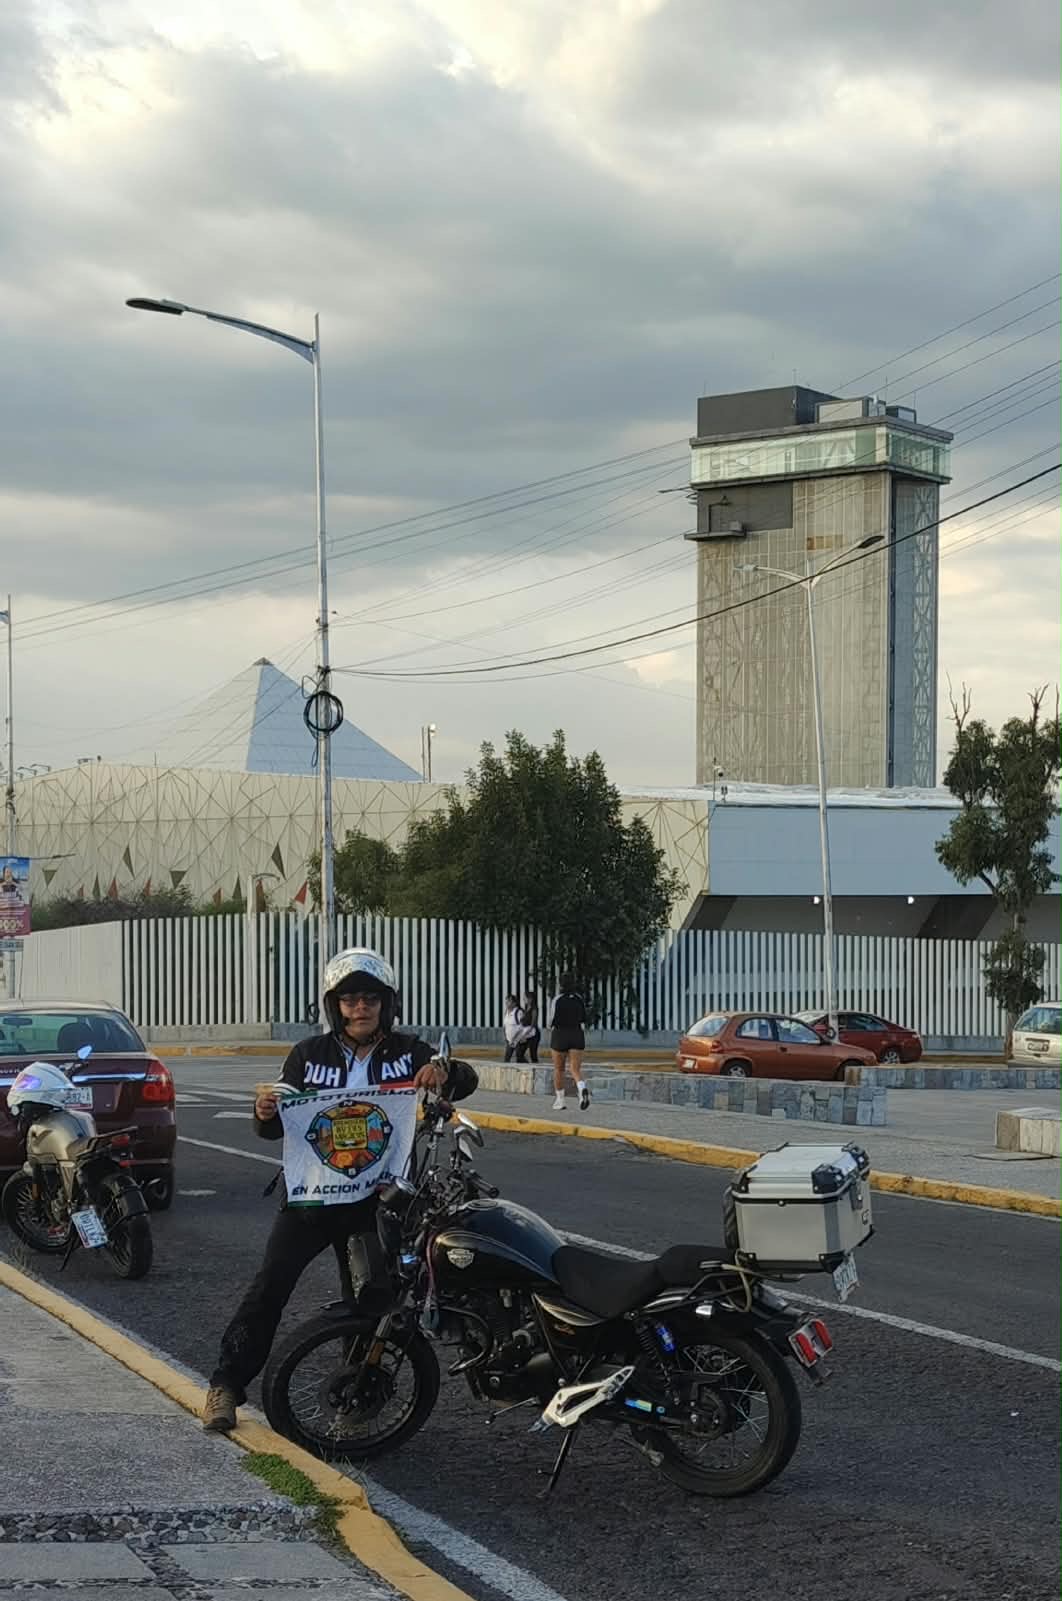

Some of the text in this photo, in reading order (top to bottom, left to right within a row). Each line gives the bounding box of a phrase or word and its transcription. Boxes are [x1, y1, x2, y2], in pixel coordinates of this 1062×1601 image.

[281, 1088, 417, 1112] MOTOTURISMO
[291, 1183, 361, 1196] EN ACCION
